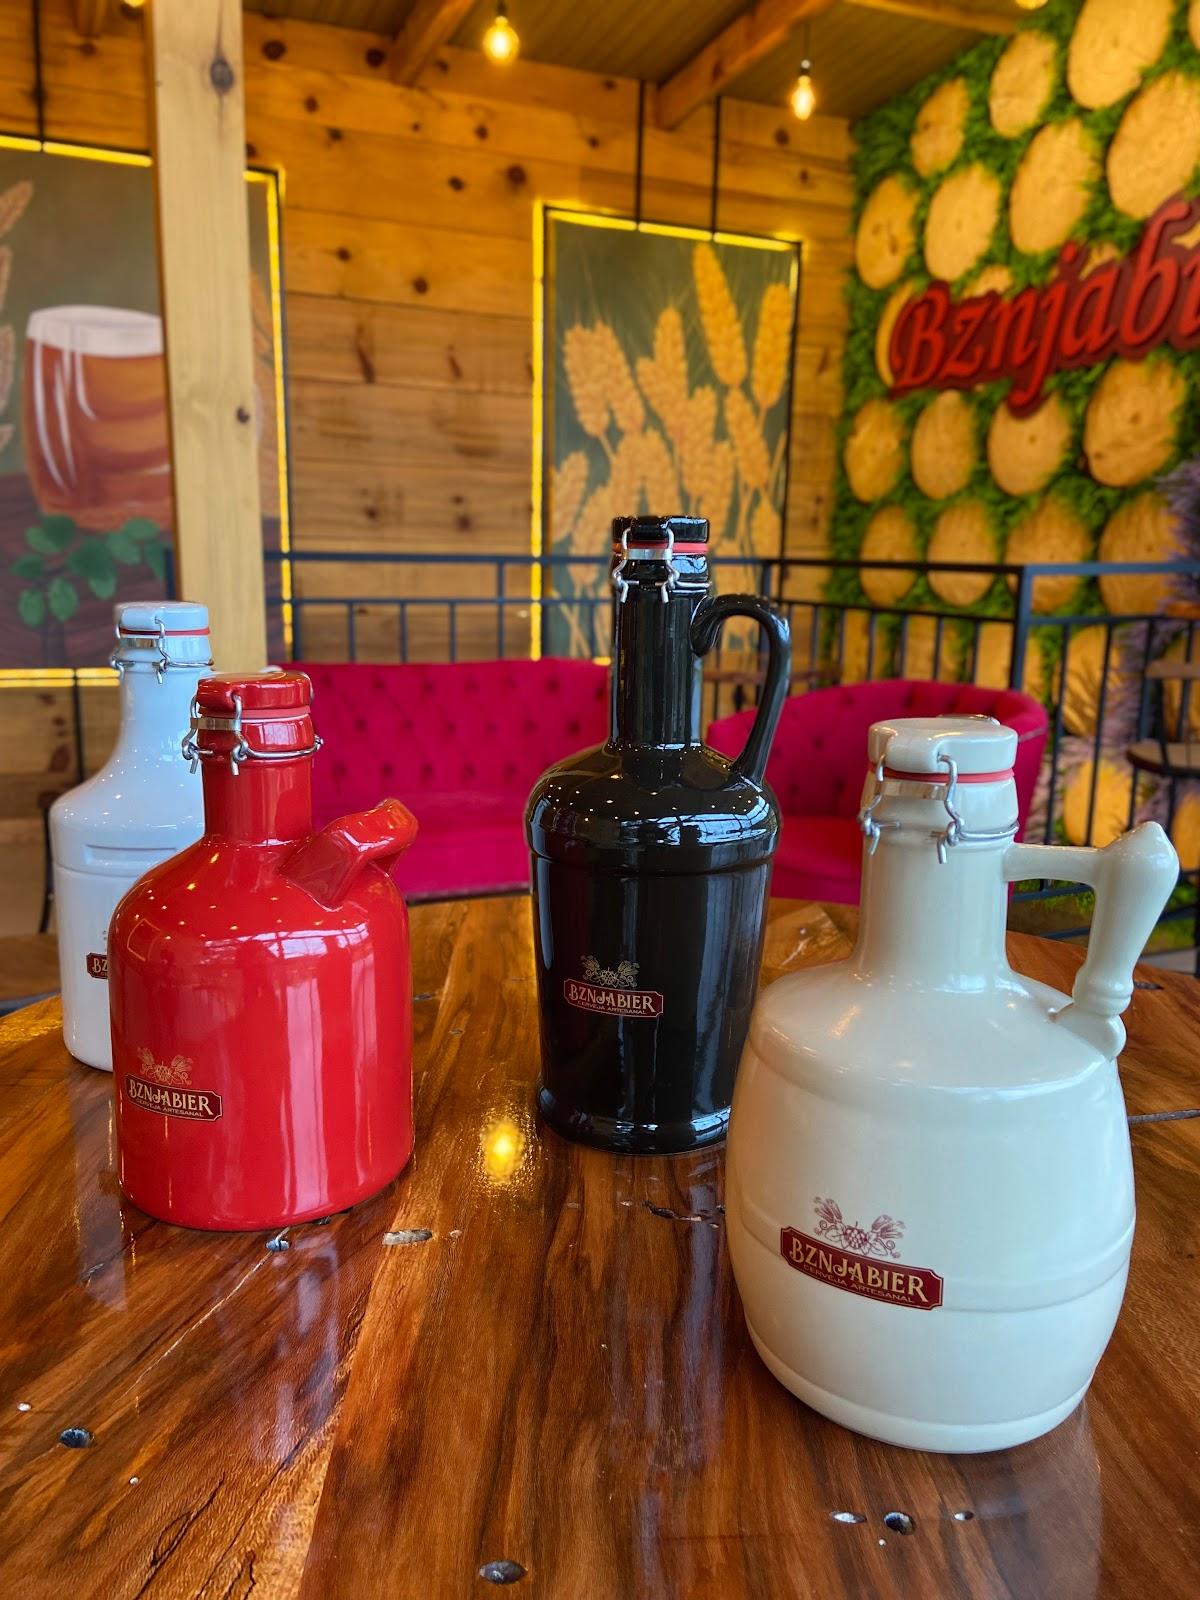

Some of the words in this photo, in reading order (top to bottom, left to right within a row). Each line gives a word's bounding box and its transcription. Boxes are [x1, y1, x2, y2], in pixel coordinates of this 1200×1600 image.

[569, 984, 656, 1012] BZNJABIER
[129, 1080, 213, 1115] BZNJABIER
[789, 1236, 928, 1302] BZNJABIER
[803, 1264, 848, 1287] CERVEJA
[850, 1283, 914, 1304] ARTESANAL
